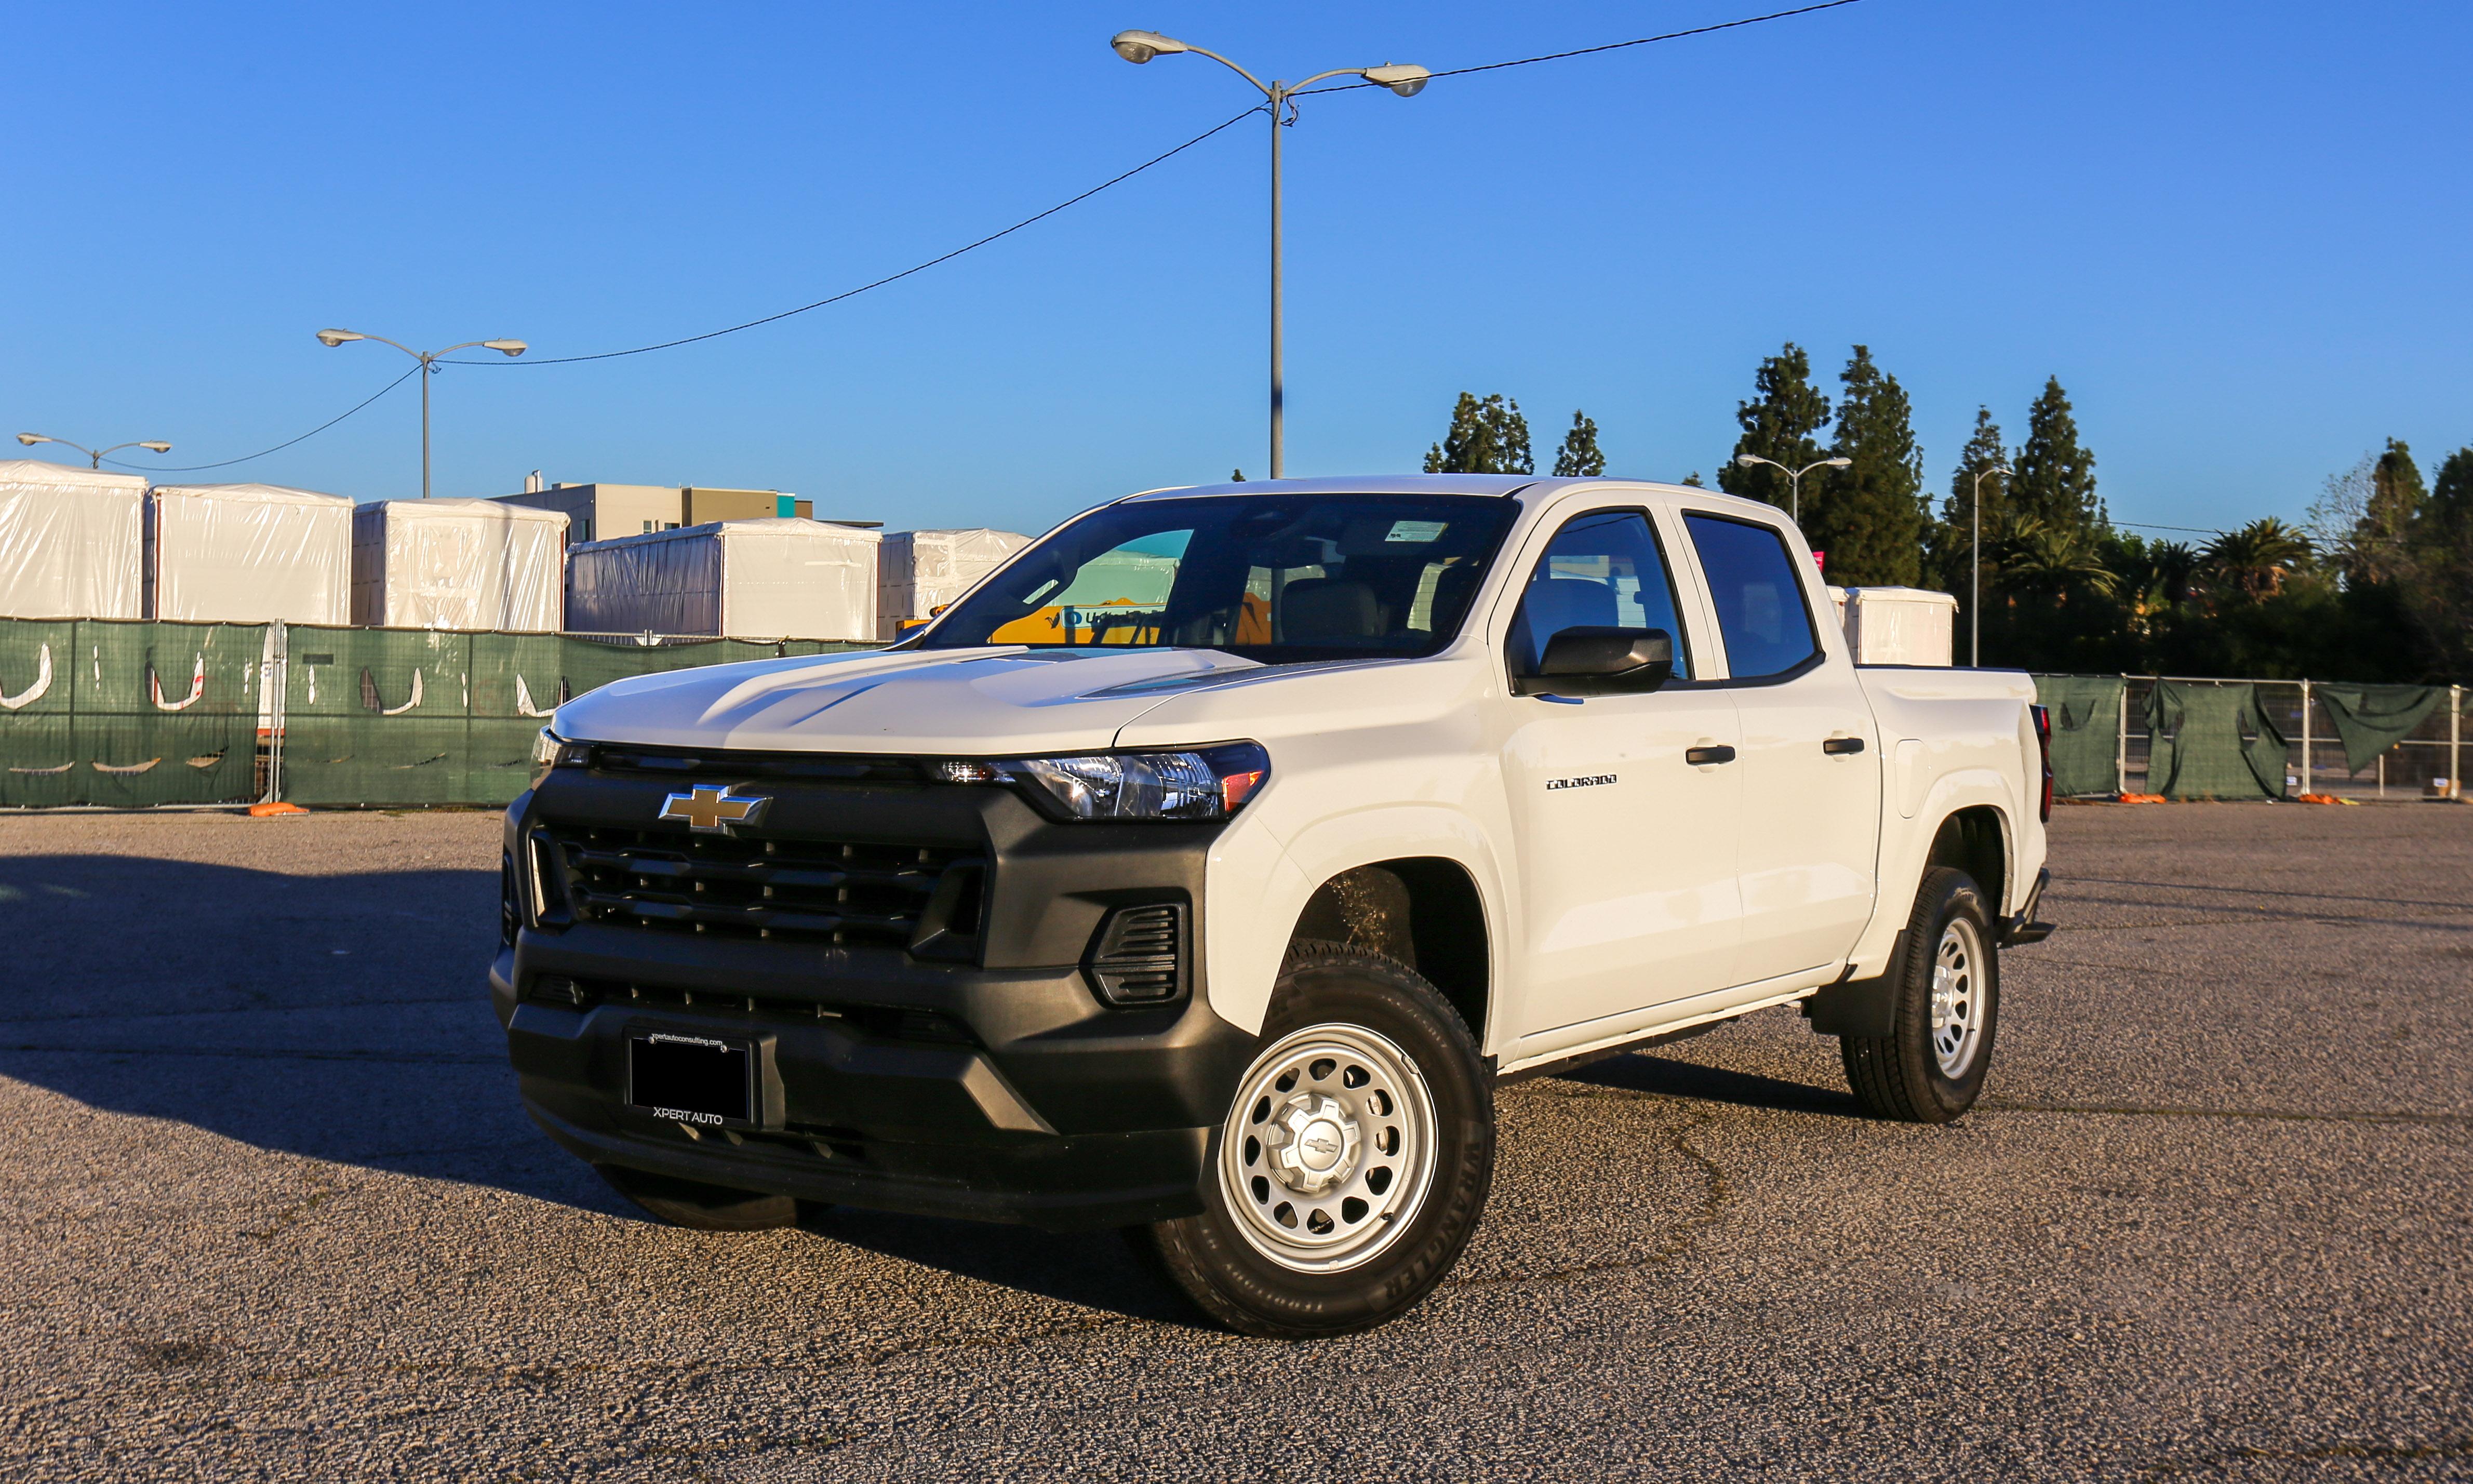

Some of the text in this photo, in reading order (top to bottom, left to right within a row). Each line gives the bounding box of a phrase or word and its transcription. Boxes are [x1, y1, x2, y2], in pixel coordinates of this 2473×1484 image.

[1546, 774, 1617, 790] COLORADO
[651, 1033, 723, 1046] xpertautoconsulting.com
[653, 1106, 723, 1125] XPERT AUTO
[1383, 1143, 1480, 1299] WRANGLER
